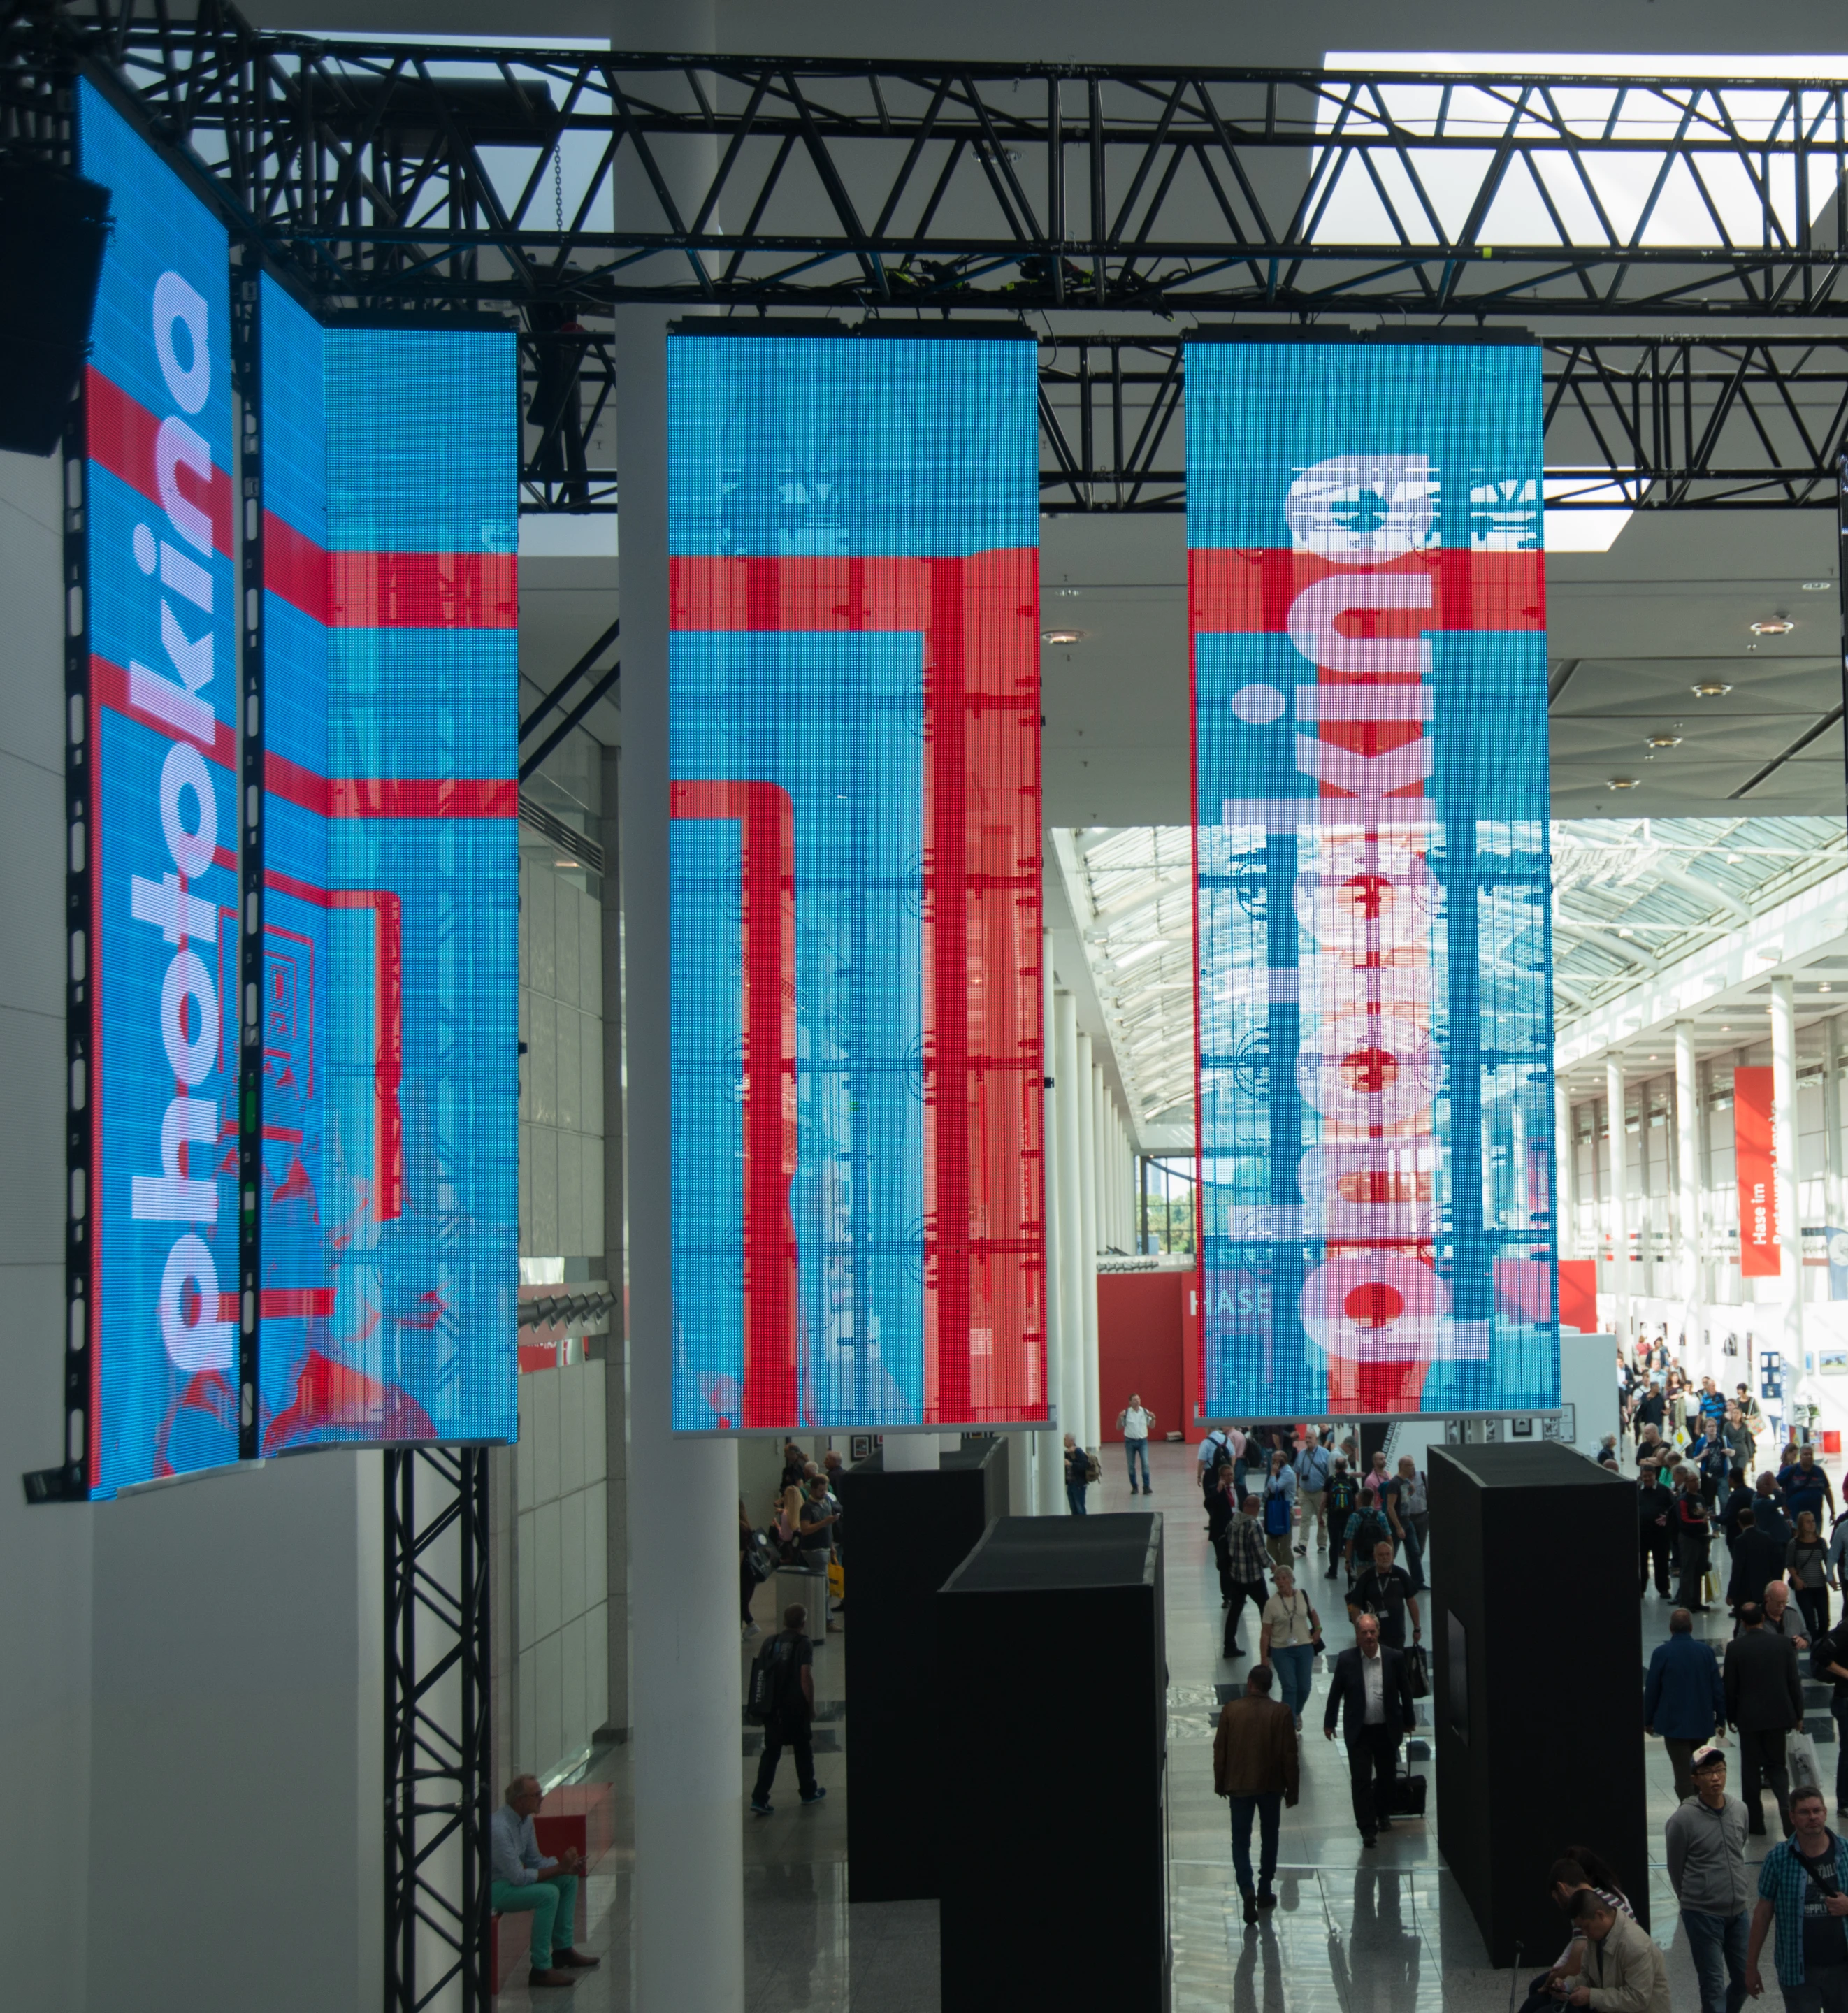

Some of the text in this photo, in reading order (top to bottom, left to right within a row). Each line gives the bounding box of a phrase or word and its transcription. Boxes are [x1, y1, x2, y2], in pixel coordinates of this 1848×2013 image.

[130, 270, 235, 1373] photokina
[1222, 454, 1489, 1362] photokina
[1751, 1183, 1766, 1244] Hase im
[1190, 1287, 1271, 1316] HASE
[755, 1669, 765, 1703] TAMRON
